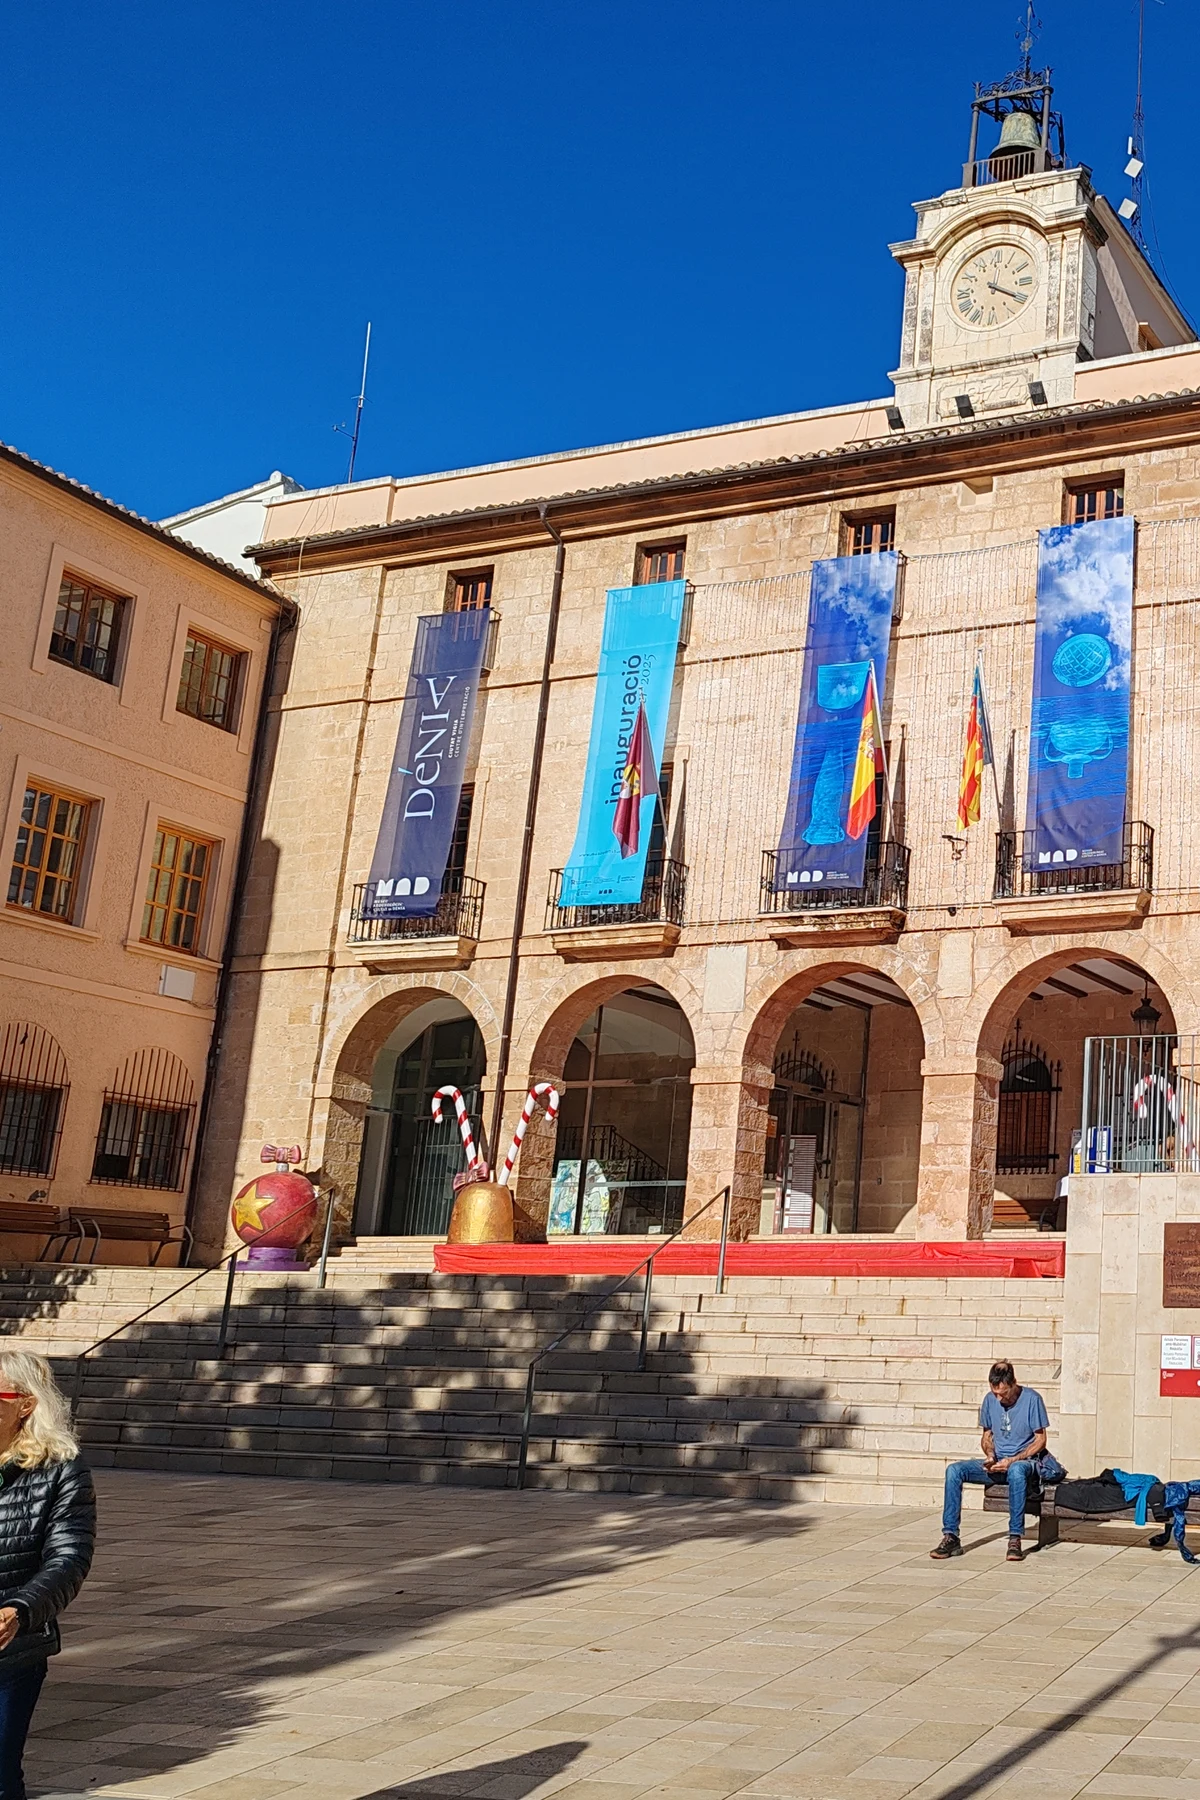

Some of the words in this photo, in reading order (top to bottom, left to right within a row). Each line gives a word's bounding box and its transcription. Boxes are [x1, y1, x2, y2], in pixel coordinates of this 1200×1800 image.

[641, 654, 657, 684] 2025
[605, 655, 641, 804] inauguració
[1038, 849, 1078, 864] MAD
[376, 876, 430, 896] MAD
[787, 870, 824, 882] MAD
